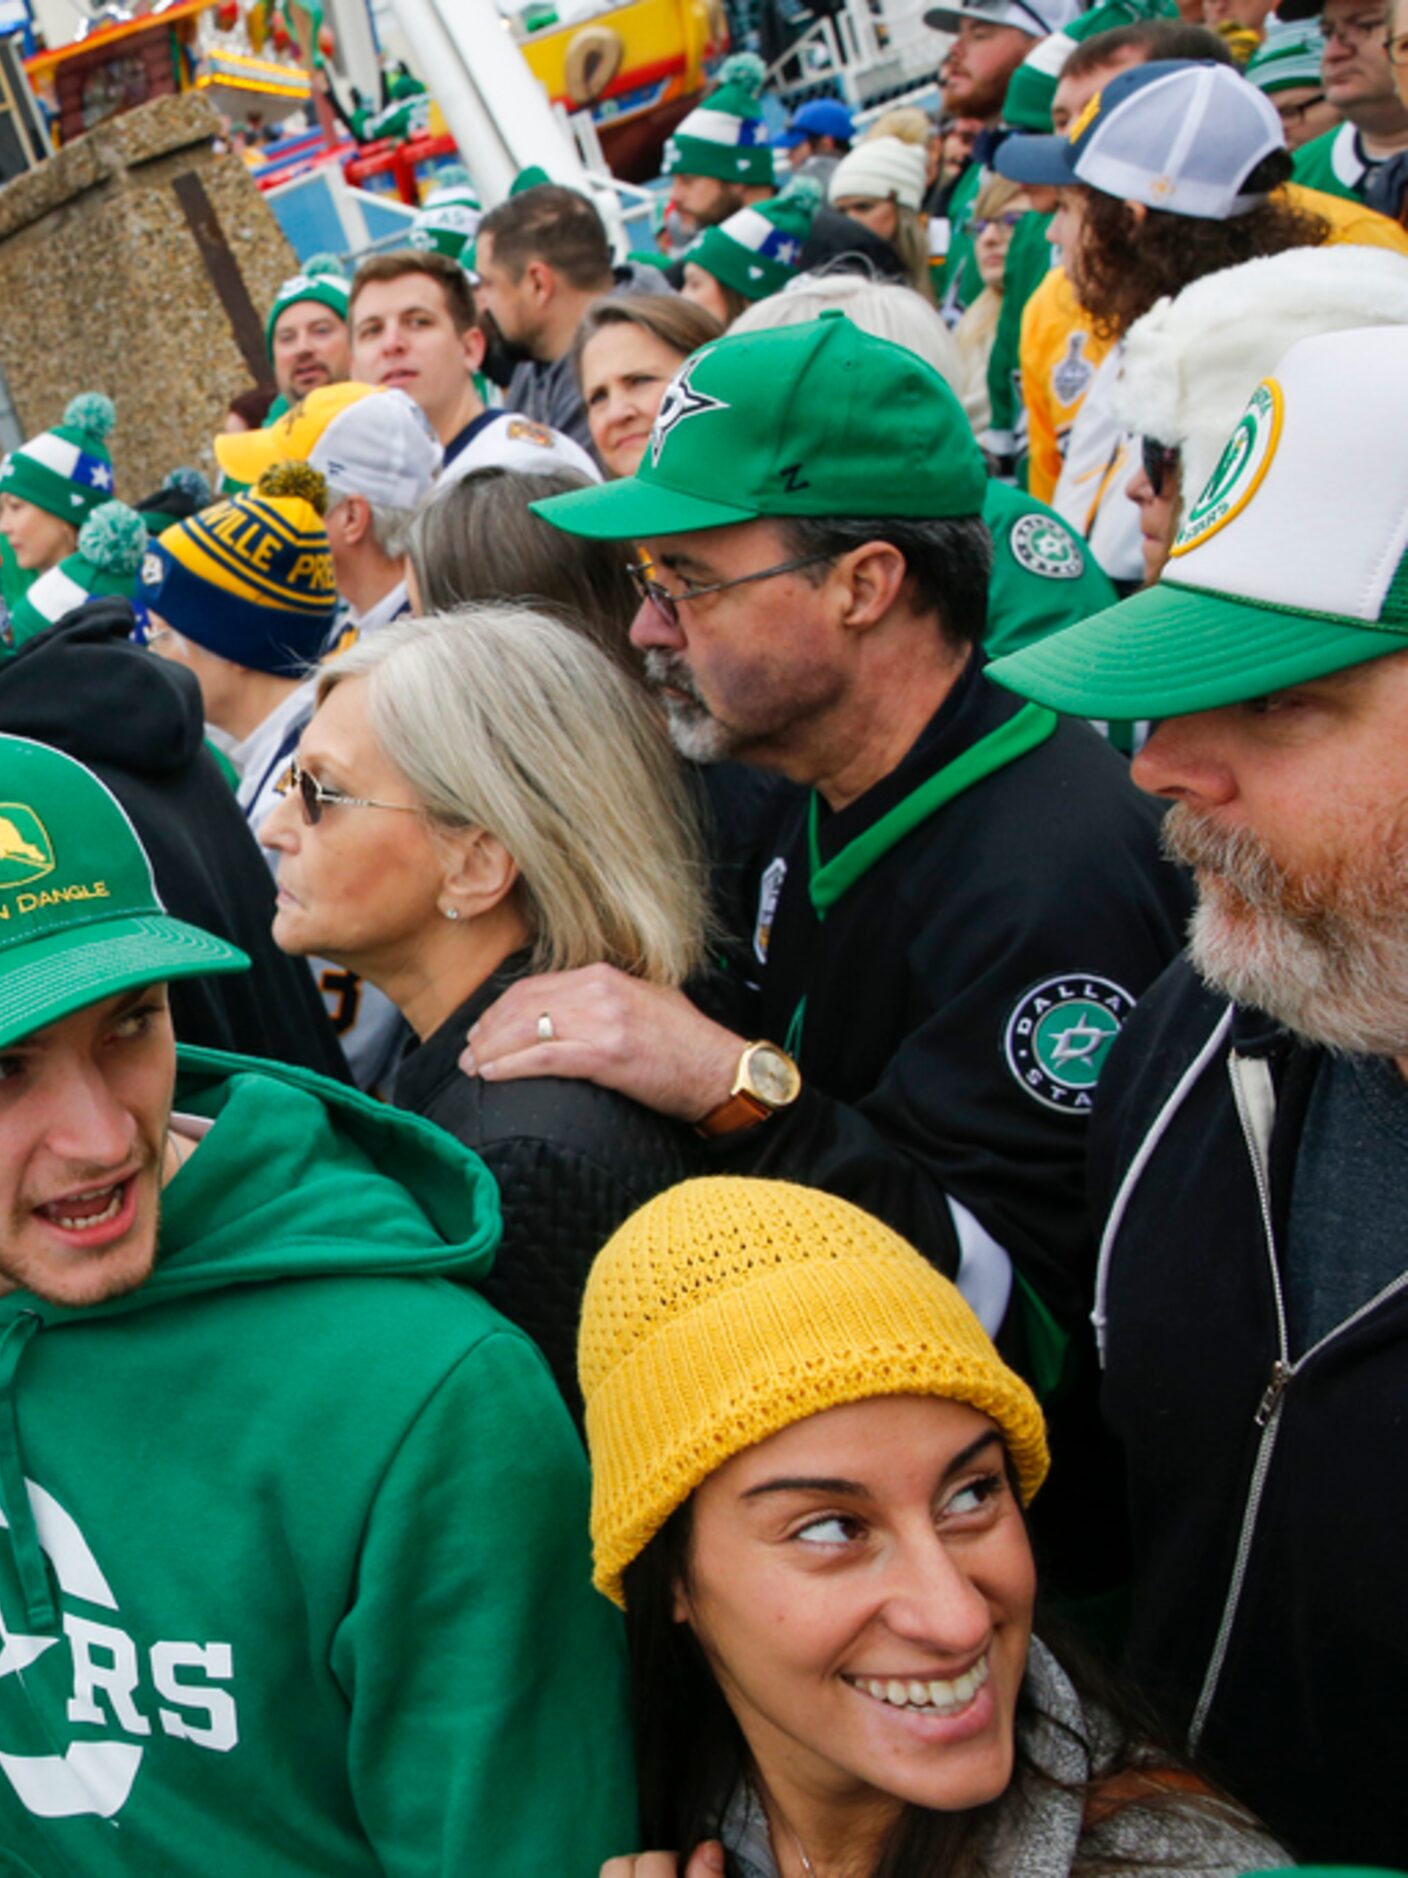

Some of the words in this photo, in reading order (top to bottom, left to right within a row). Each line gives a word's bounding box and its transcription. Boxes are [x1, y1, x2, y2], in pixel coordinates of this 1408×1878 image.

[16, 879, 111, 914] DANGLE
[1016, 983, 1127, 1036] DALLA
[1025, 1067, 1092, 1107] STA
